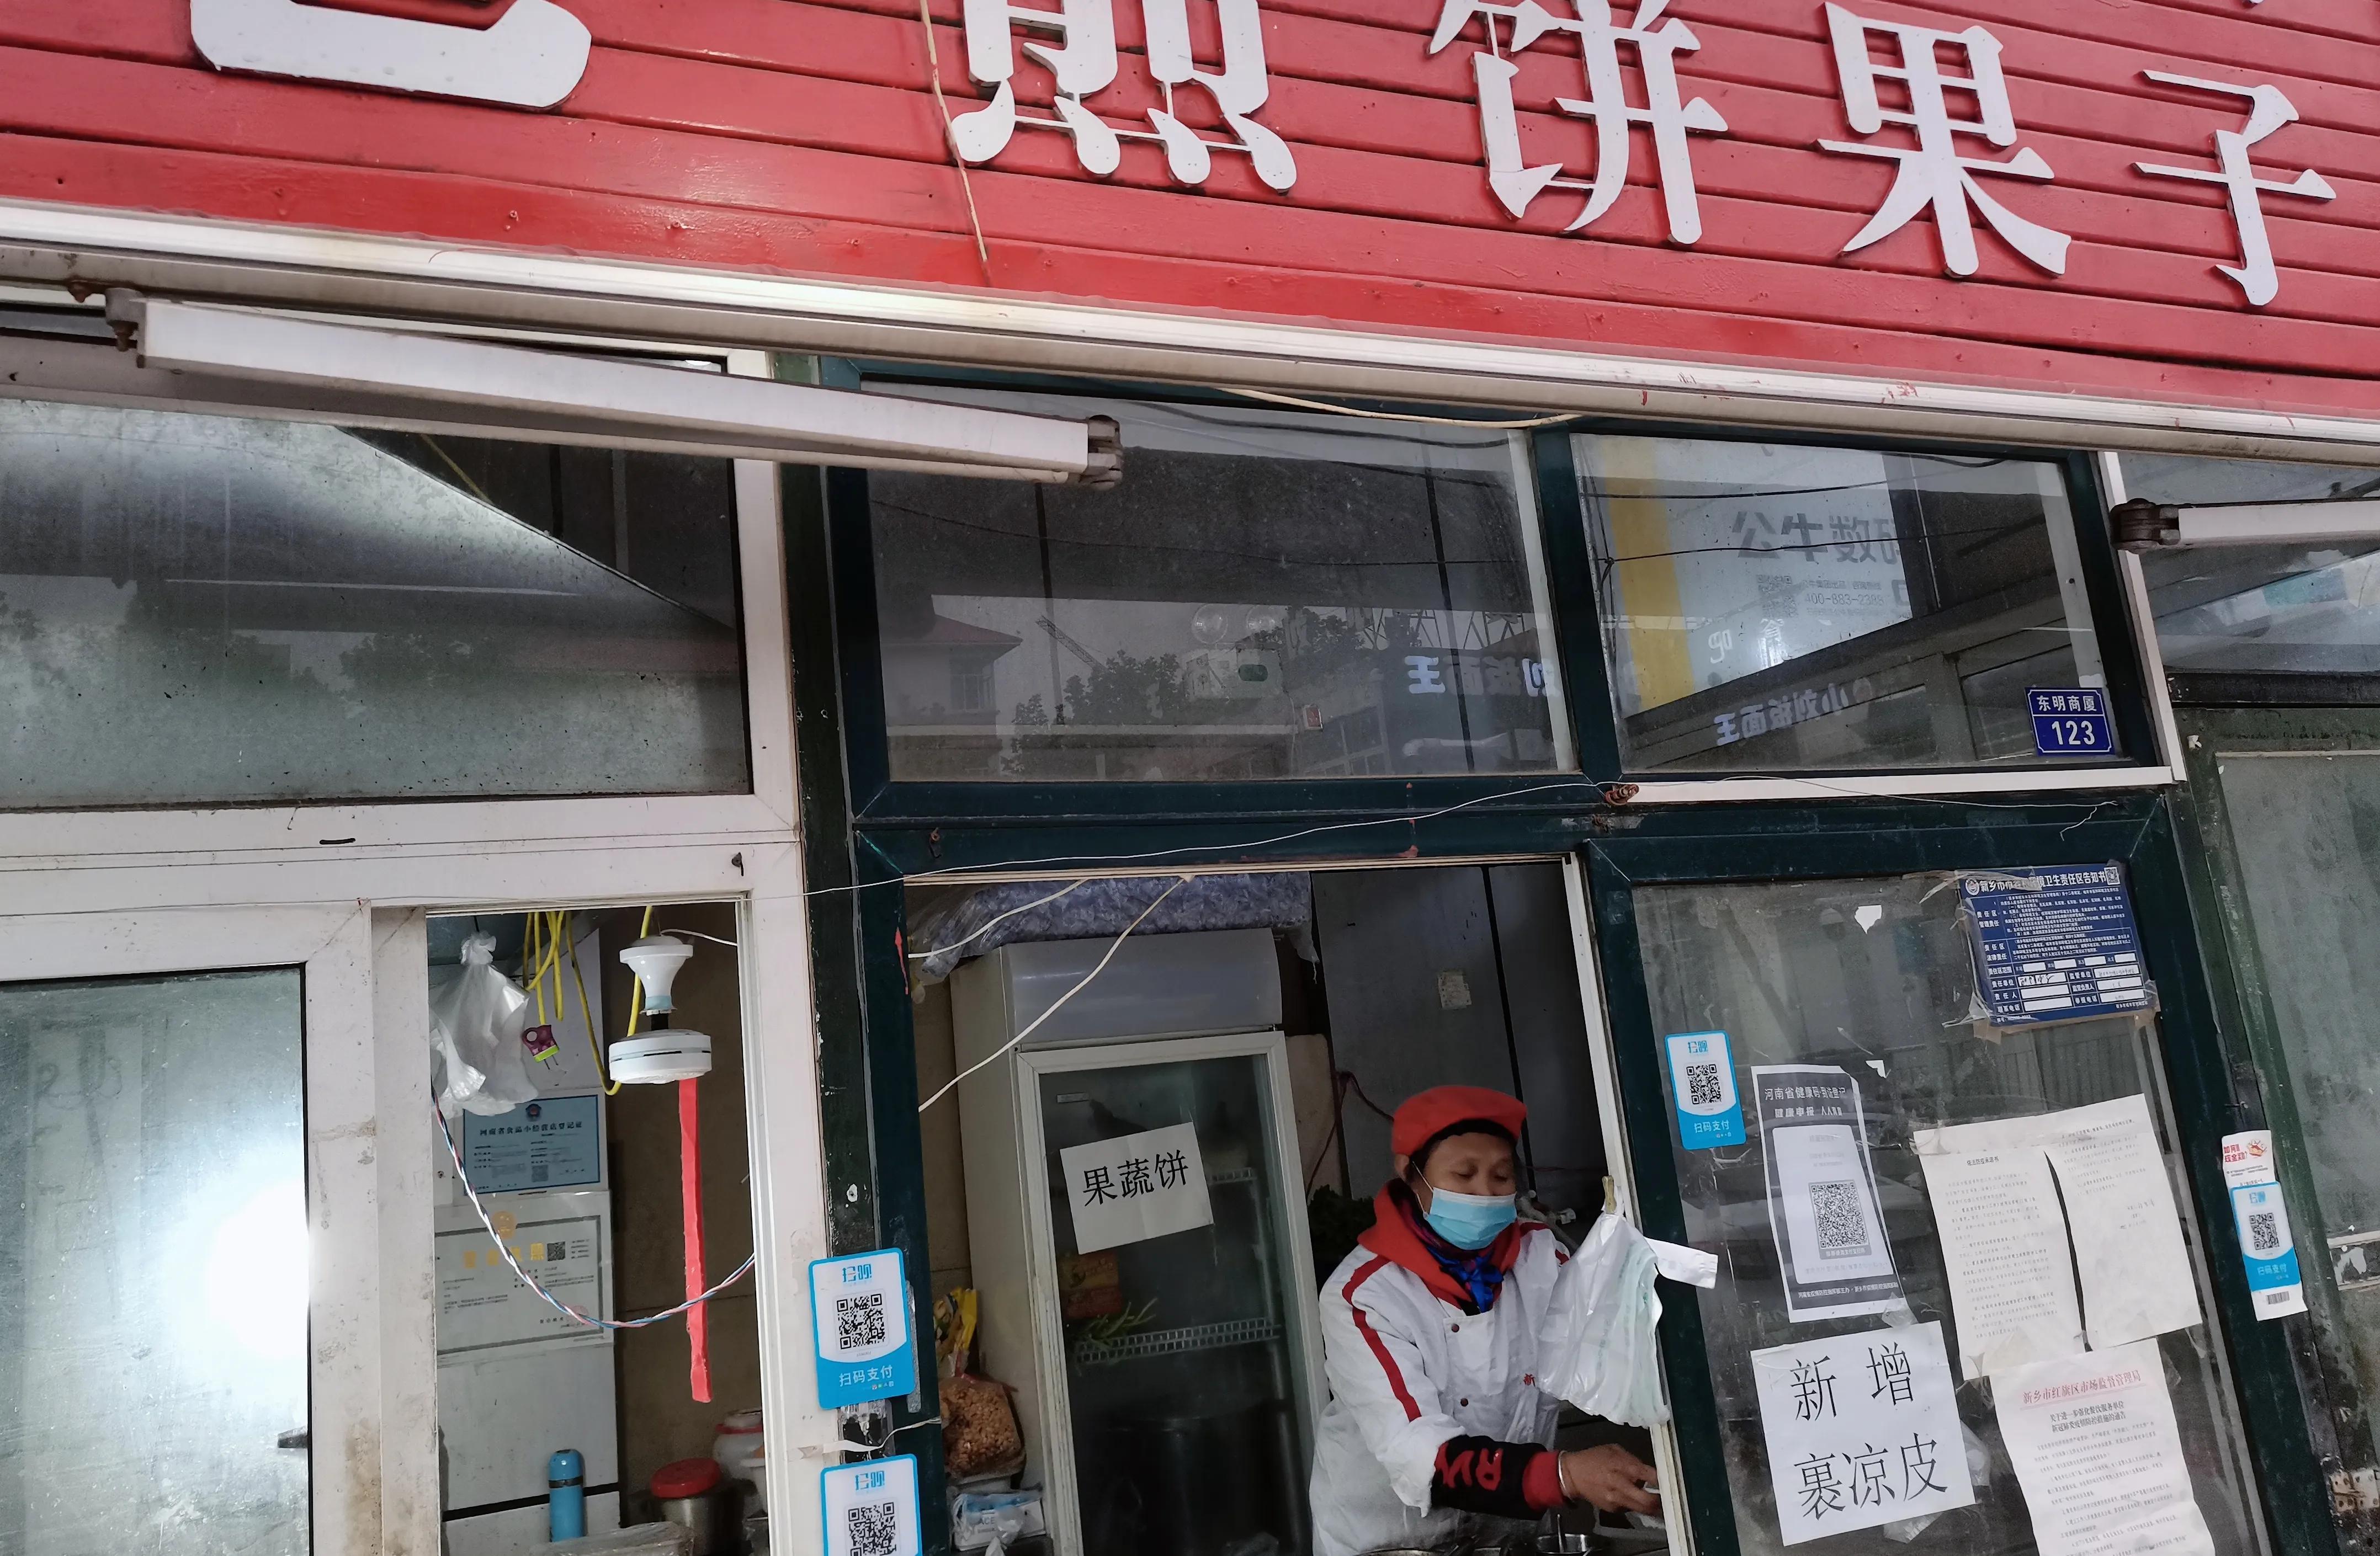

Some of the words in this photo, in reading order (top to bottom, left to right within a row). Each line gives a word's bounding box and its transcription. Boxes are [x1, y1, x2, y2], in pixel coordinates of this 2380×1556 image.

[2037, 695, 2097, 712] 东明商厦
[2052, 721, 2095, 745] 123
[1994, 992, 2018, 1000] 责任人
[1694, 1120, 1730, 1133] 扫码支付
[1081, 1149, 1190, 1207] 果蔬饼
[839, 1365, 893, 1387] 扫码支付
[1789, 1342, 1914, 1422] 新增
[2022, 1370, 2142, 1404] 新乡市红旗区市场监督管理局
[1793, 1433, 1948, 1521] 裹凉皮
